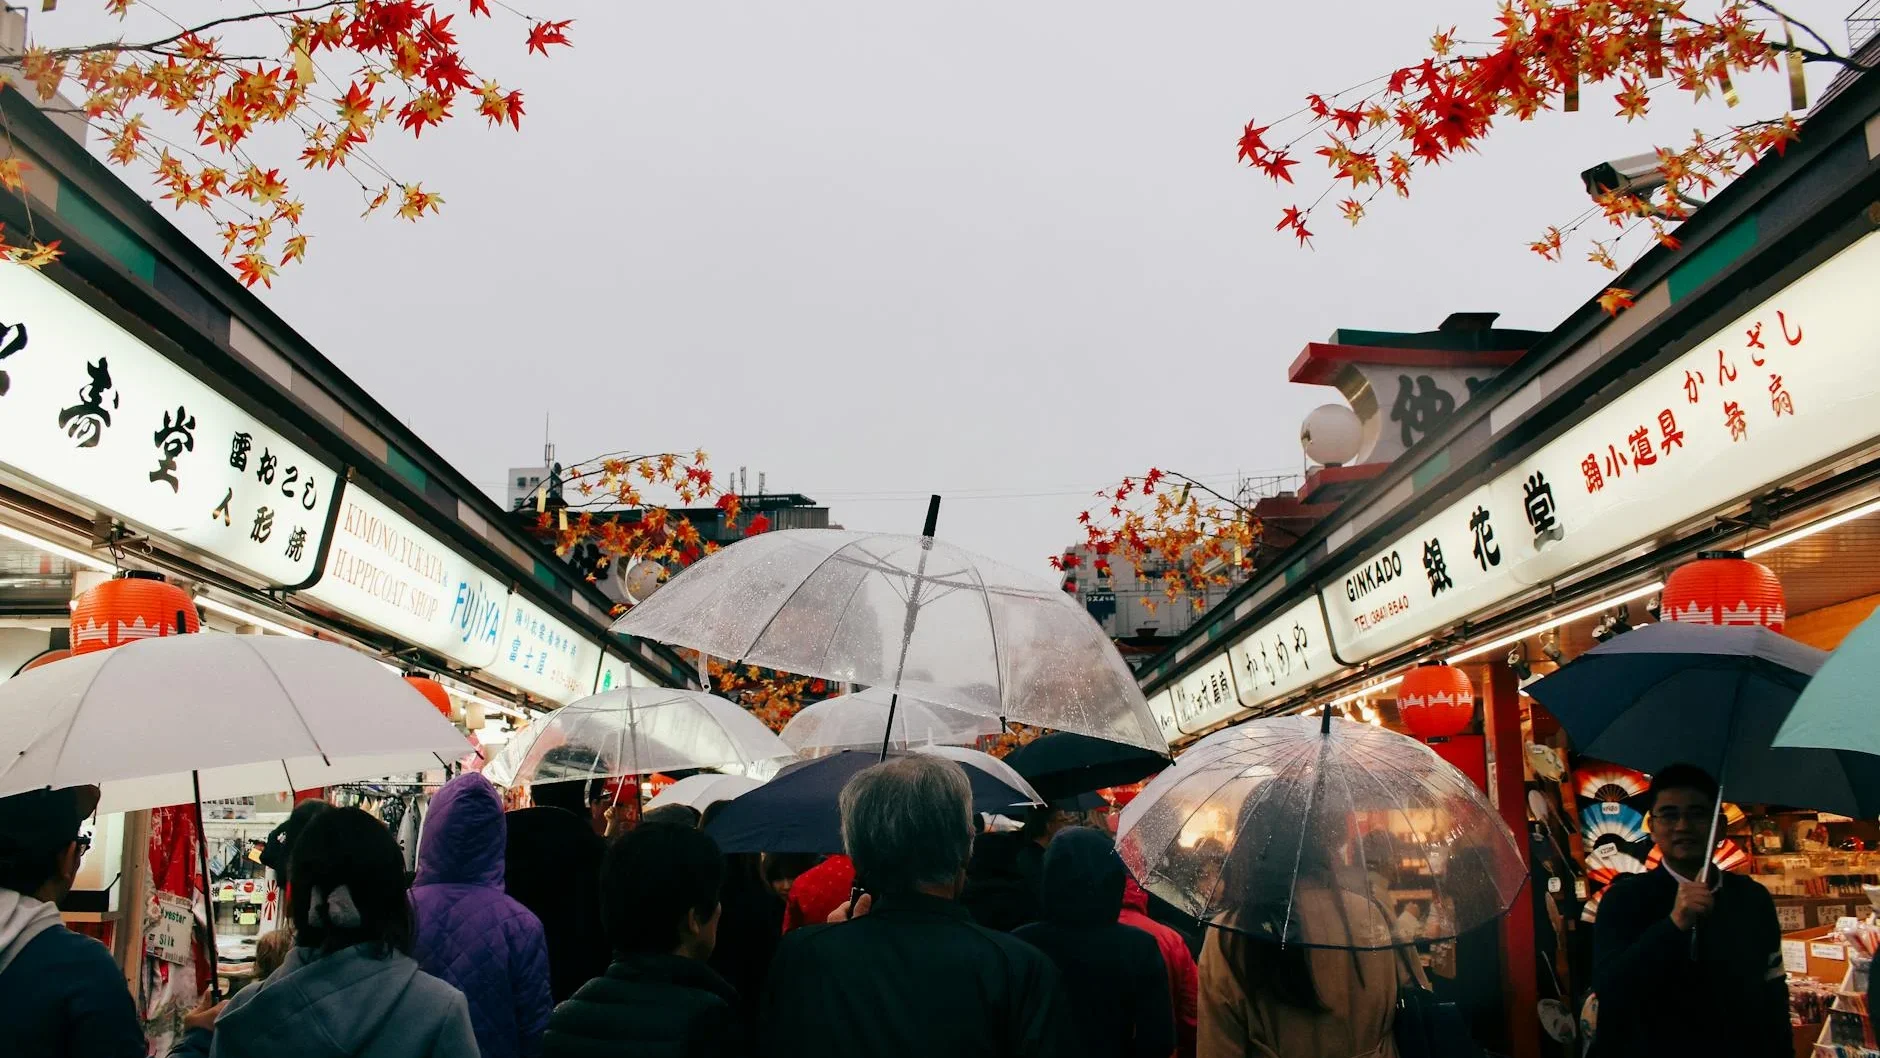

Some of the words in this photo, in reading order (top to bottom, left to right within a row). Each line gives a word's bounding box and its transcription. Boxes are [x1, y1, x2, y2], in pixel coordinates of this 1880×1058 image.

[1684, 310, 1803, 404] かんざし
[230, 431, 317, 511] 雷おこし
[1580, 408, 1684, 495] 踊小道具
[212, 487, 307, 562] 人形焼
[400, 536, 443, 584] YUKATA
[1421, 471, 1564, 598] 銀花堂
[333, 547, 408, 607] HAPPICOAT
[411, 588, 439, 622] SHOP
[1346, 550, 1402, 602] GINKADO
[159, 933, 175, 948] Silk
